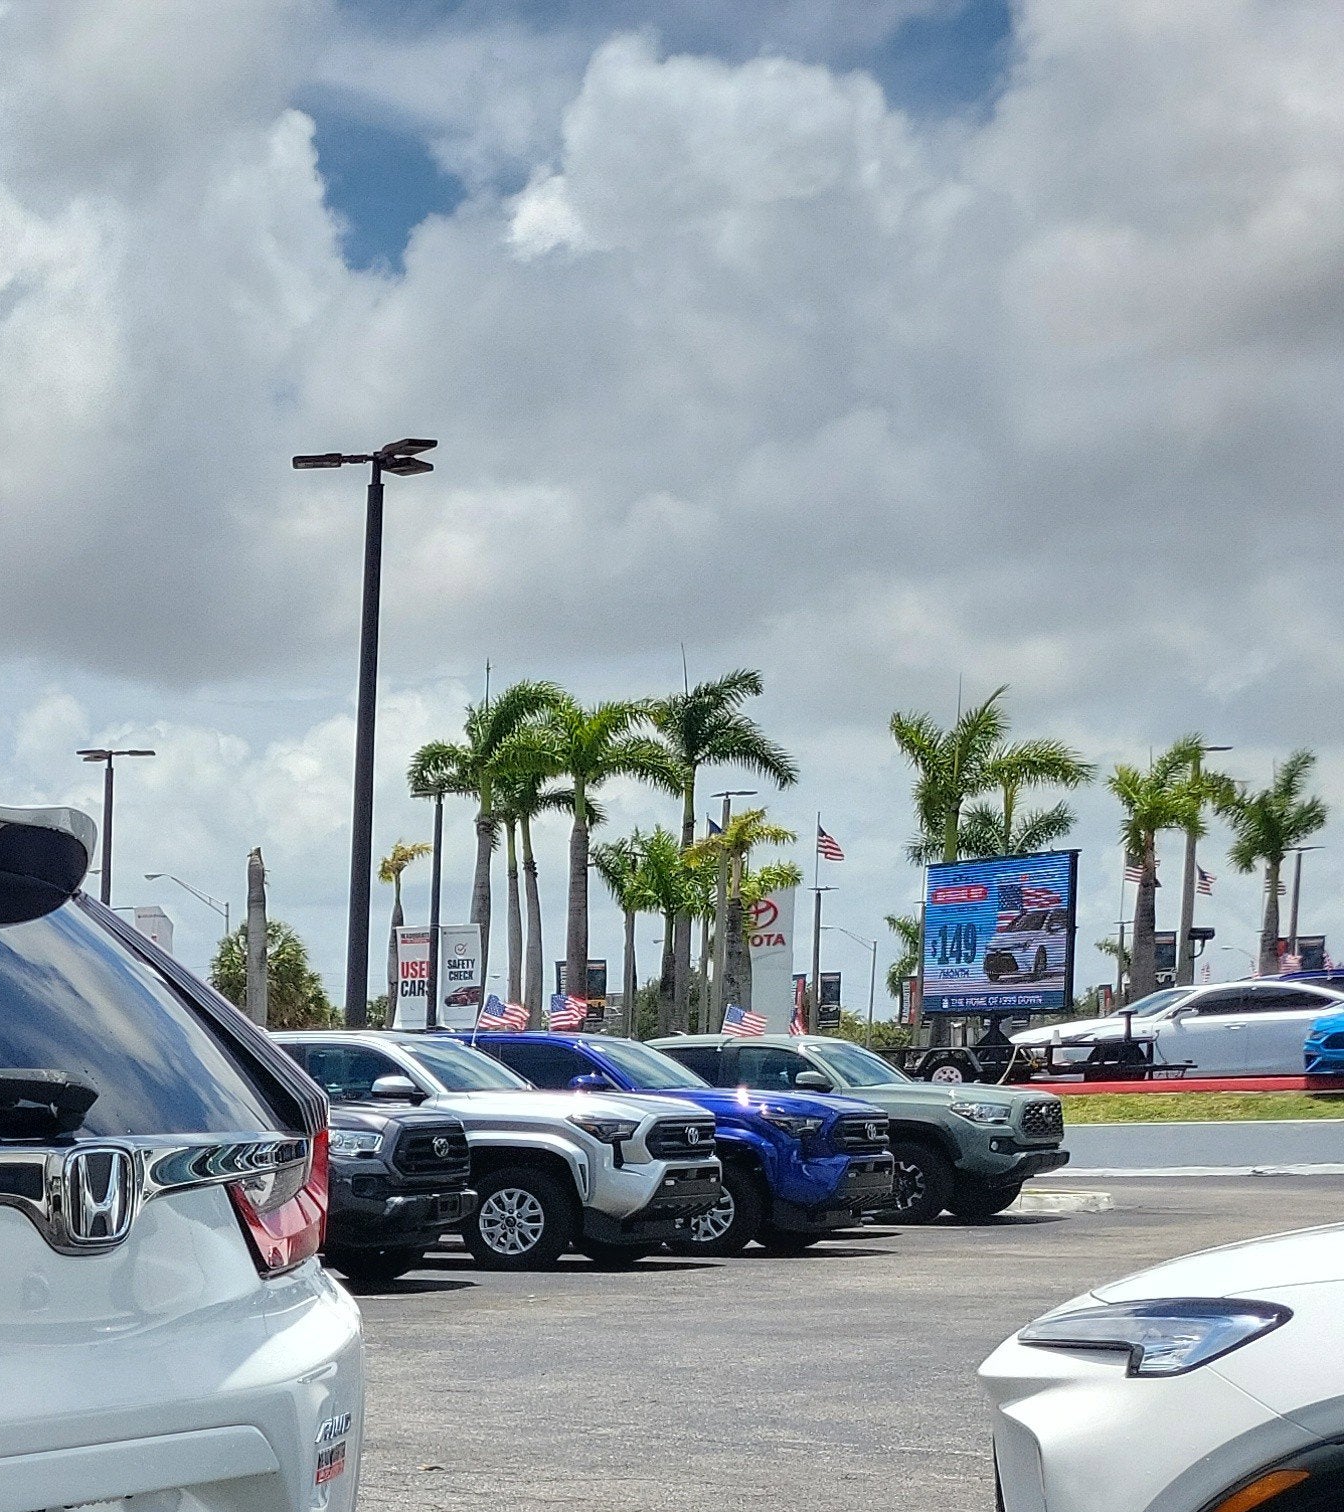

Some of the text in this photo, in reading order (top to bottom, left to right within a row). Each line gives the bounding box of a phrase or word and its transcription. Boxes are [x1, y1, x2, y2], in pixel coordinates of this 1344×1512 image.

[749, 933, 787, 947] OTA
[446, 958, 476, 970] SAFETY
[448, 970, 474, 981] CHECK
